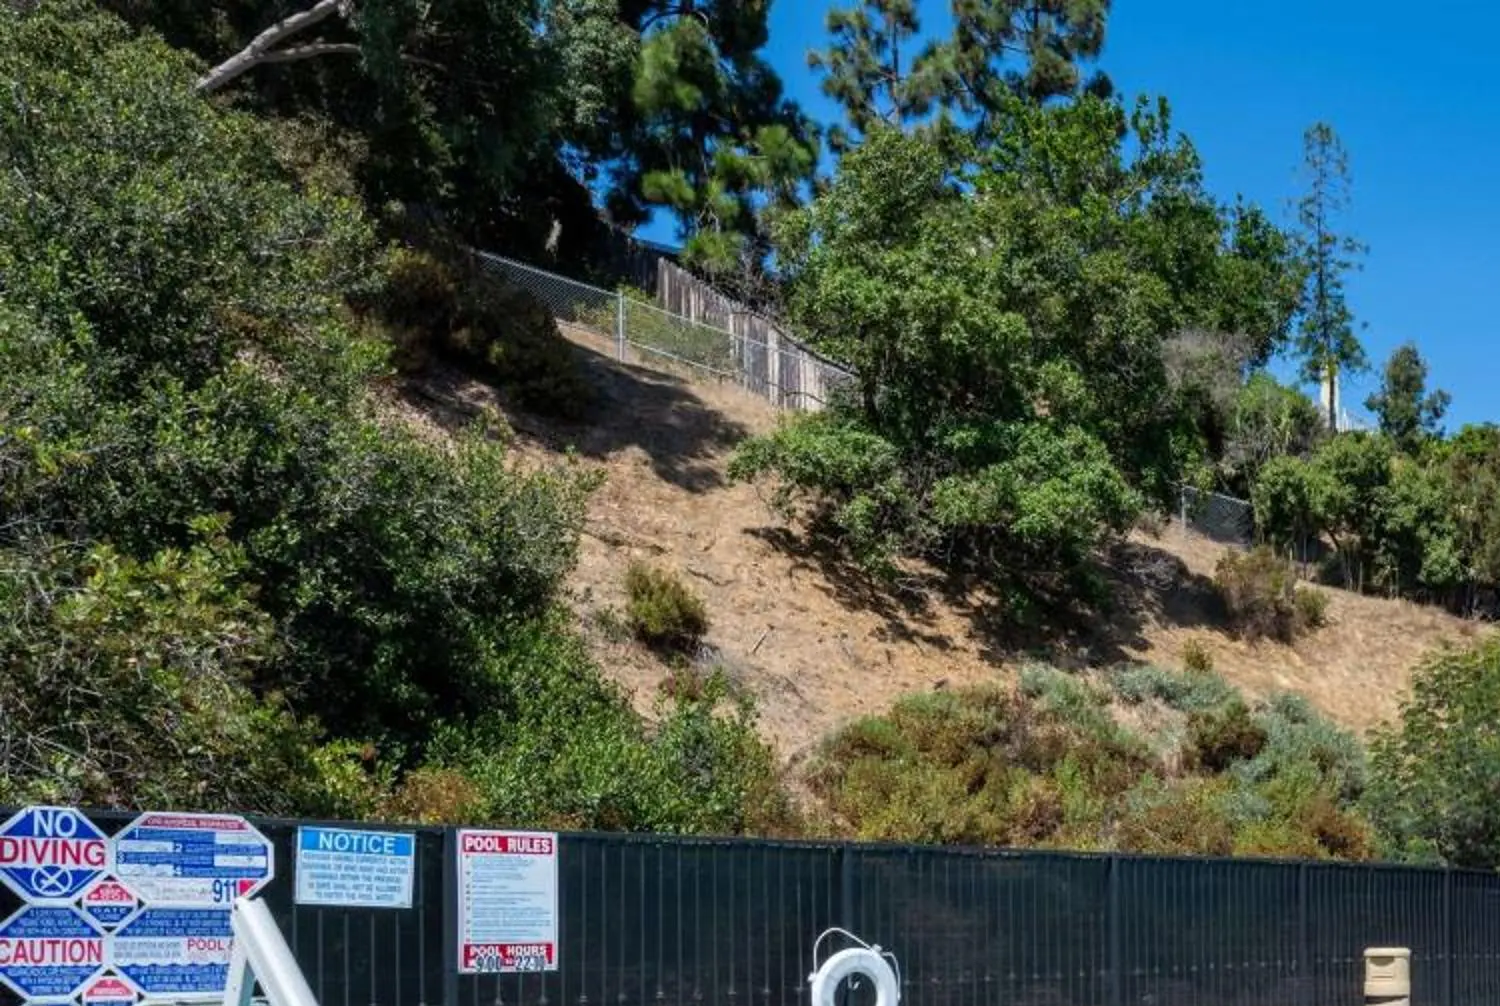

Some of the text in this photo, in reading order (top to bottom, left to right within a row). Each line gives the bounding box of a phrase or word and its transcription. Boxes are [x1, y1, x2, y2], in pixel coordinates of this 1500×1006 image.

[33, 811, 77, 837] NO
[0, 838, 105, 866] DIVING
[319, 832, 395, 854] NOTICE
[464, 836, 551, 854] POOL RULES
[213, 880, 236, 902] 911
[187, 939, 224, 951] POOL
[469, 945, 546, 957] POOL HOURS
